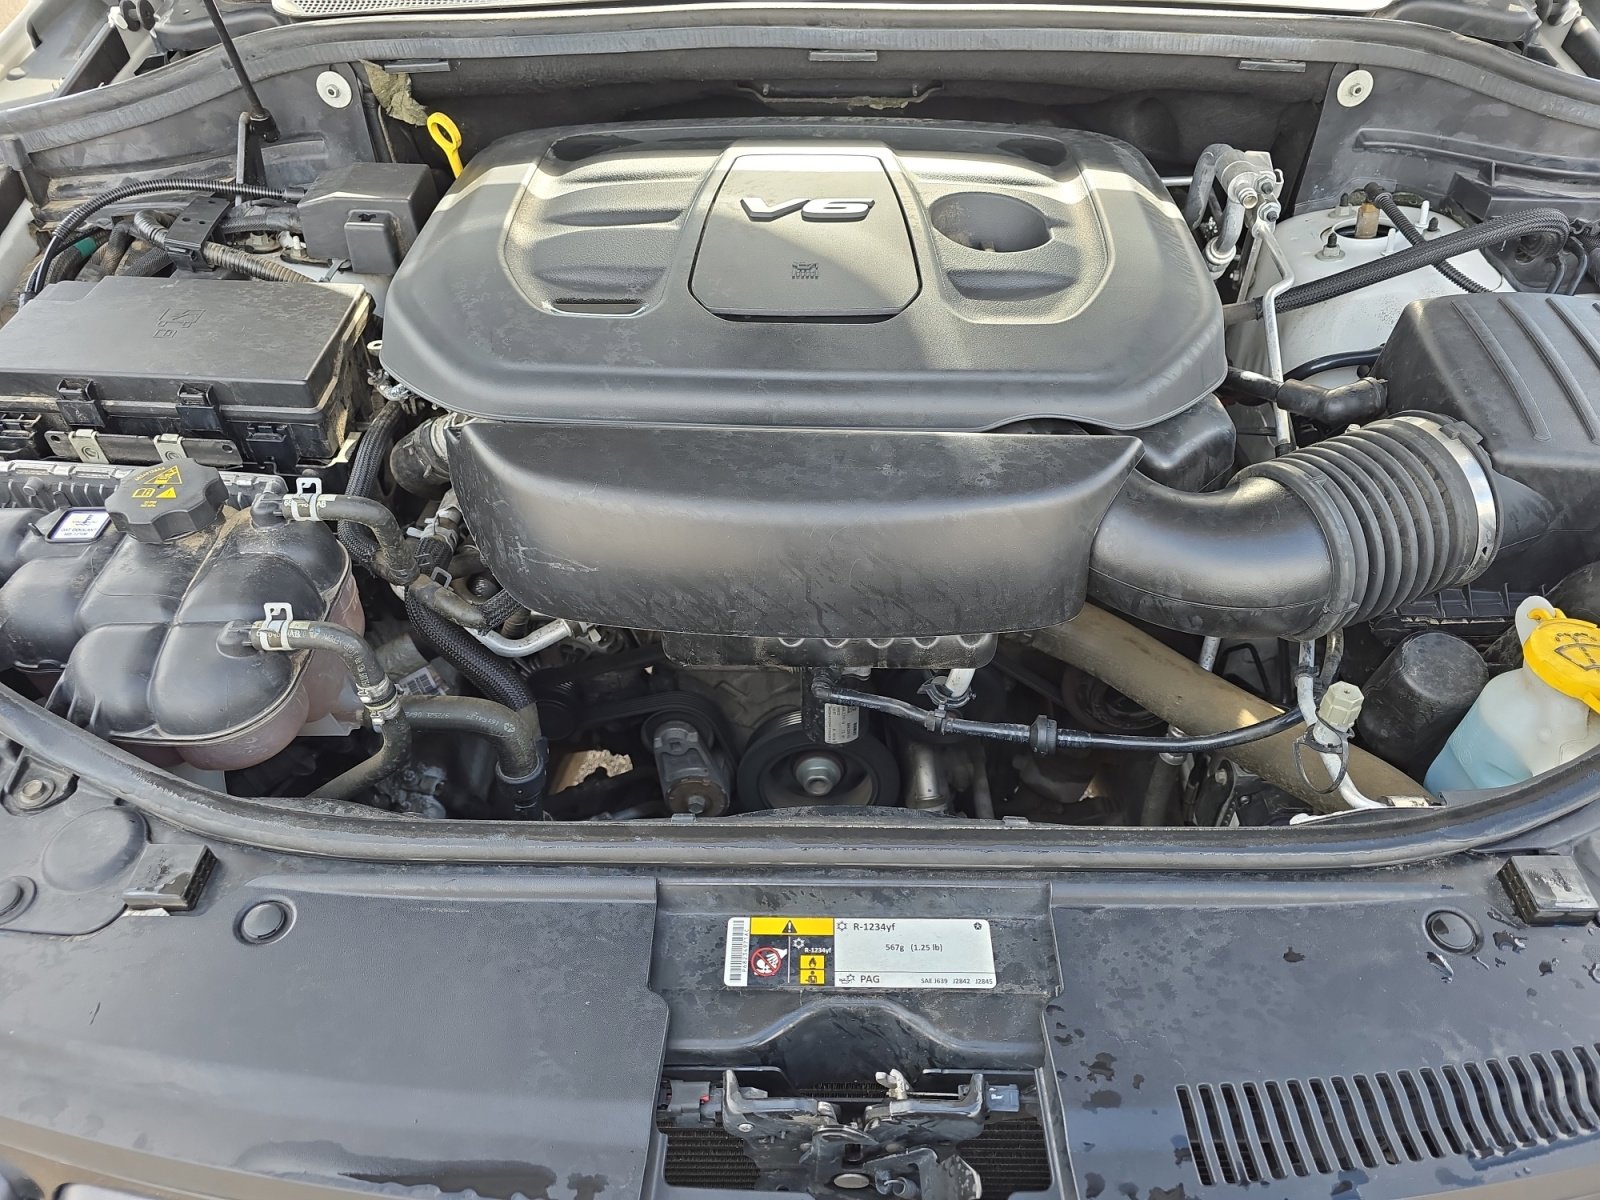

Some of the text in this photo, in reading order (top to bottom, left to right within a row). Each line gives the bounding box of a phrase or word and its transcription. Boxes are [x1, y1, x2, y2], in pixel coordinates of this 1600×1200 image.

[740, 198, 875, 222] V6
[853, 922, 895, 932] R-1234yf
[885, 943, 943, 953] 567g (1.25 lb)
[860, 975, 880, 984] PAG
